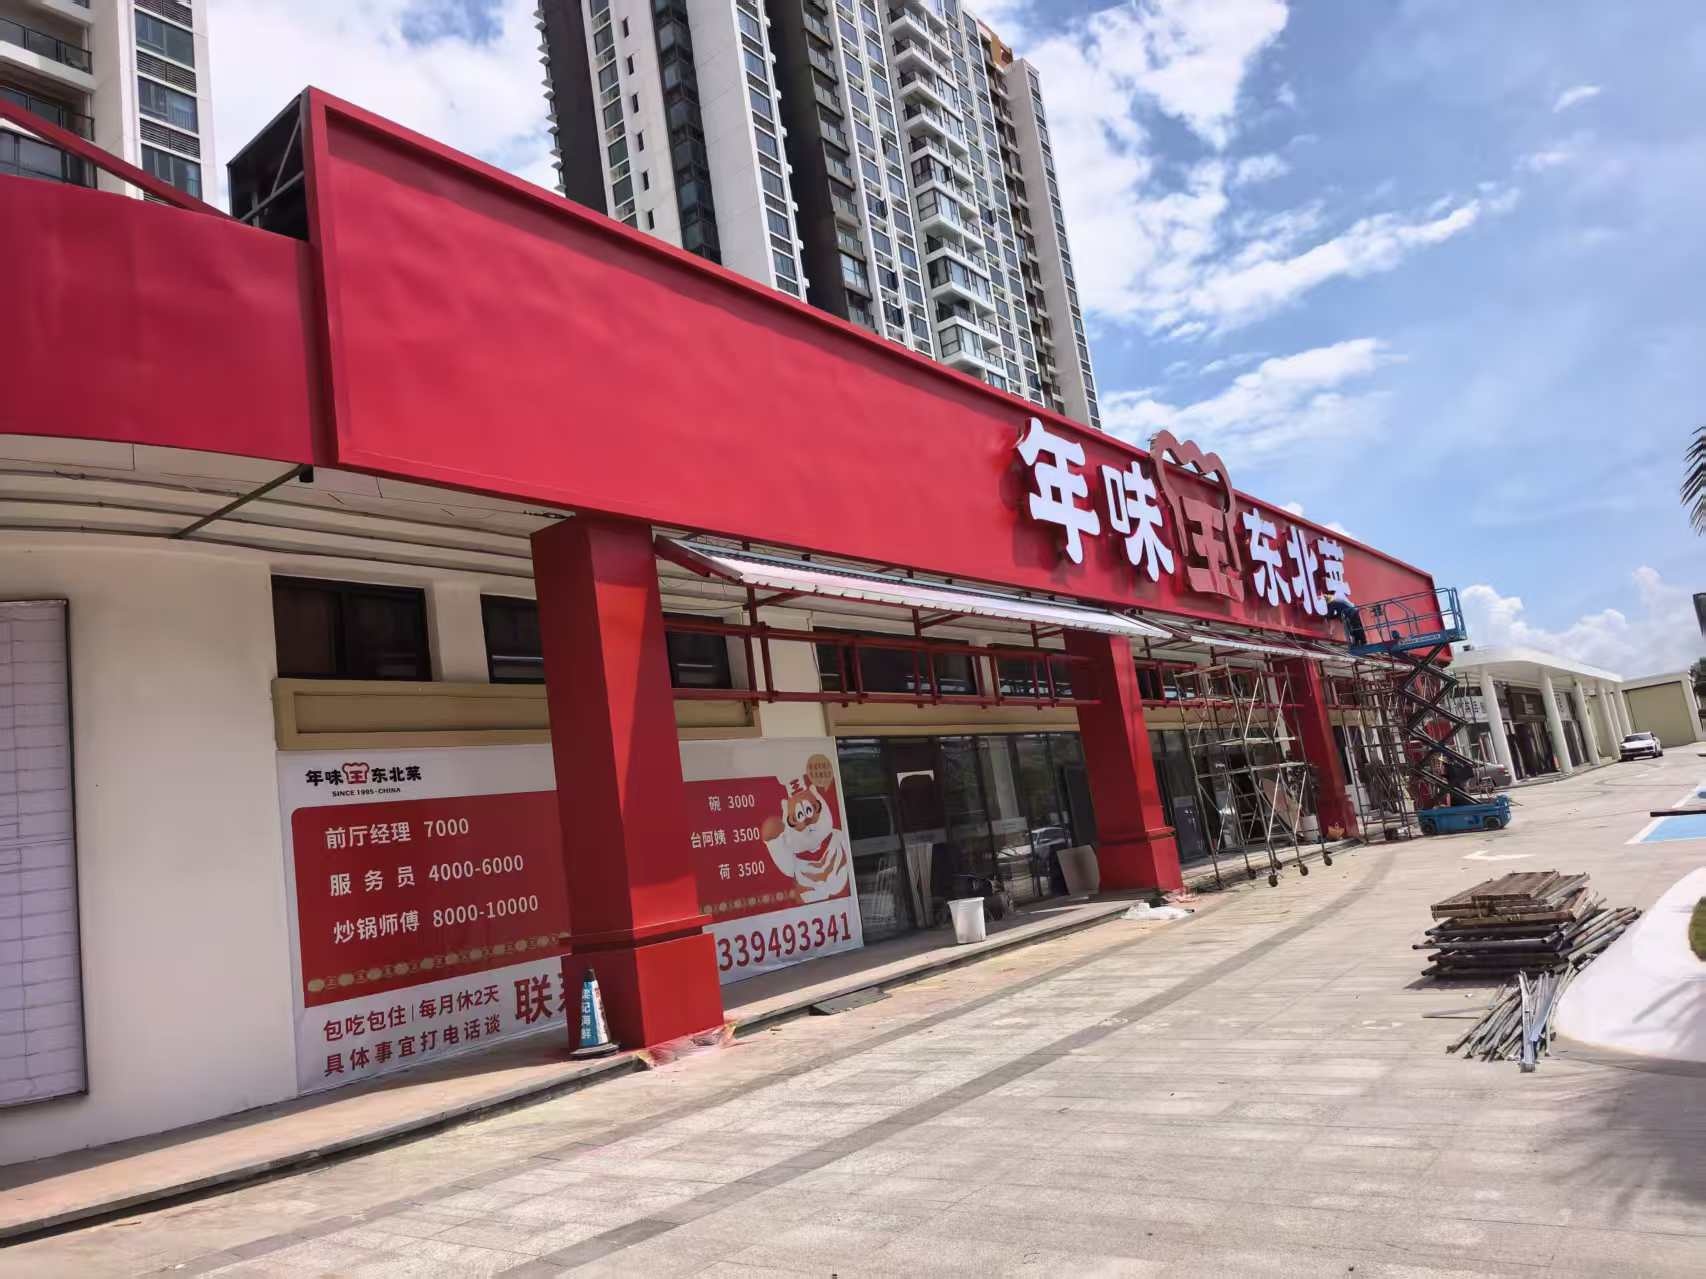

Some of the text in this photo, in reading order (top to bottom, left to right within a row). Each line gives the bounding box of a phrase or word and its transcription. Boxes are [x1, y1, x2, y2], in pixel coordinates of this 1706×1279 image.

[332, 789, 355, 797] SINCE
[708, 794, 755, 812] 碗 3000
[324, 818, 469, 849] 前厅经理 7000
[690, 827, 760, 849] 台阿姨 3500
[428, 854, 524, 883] 4000-6000
[738, 860, 765, 878] 3500
[333, 894, 539, 945] 炒锅师傅 8000-10000
[717, 911, 852, 972] 339493341
[323, 984, 500, 1042] 包吃包住 每月休2天
[324, 1014, 501, 1077] 具体事宜打电话谈
